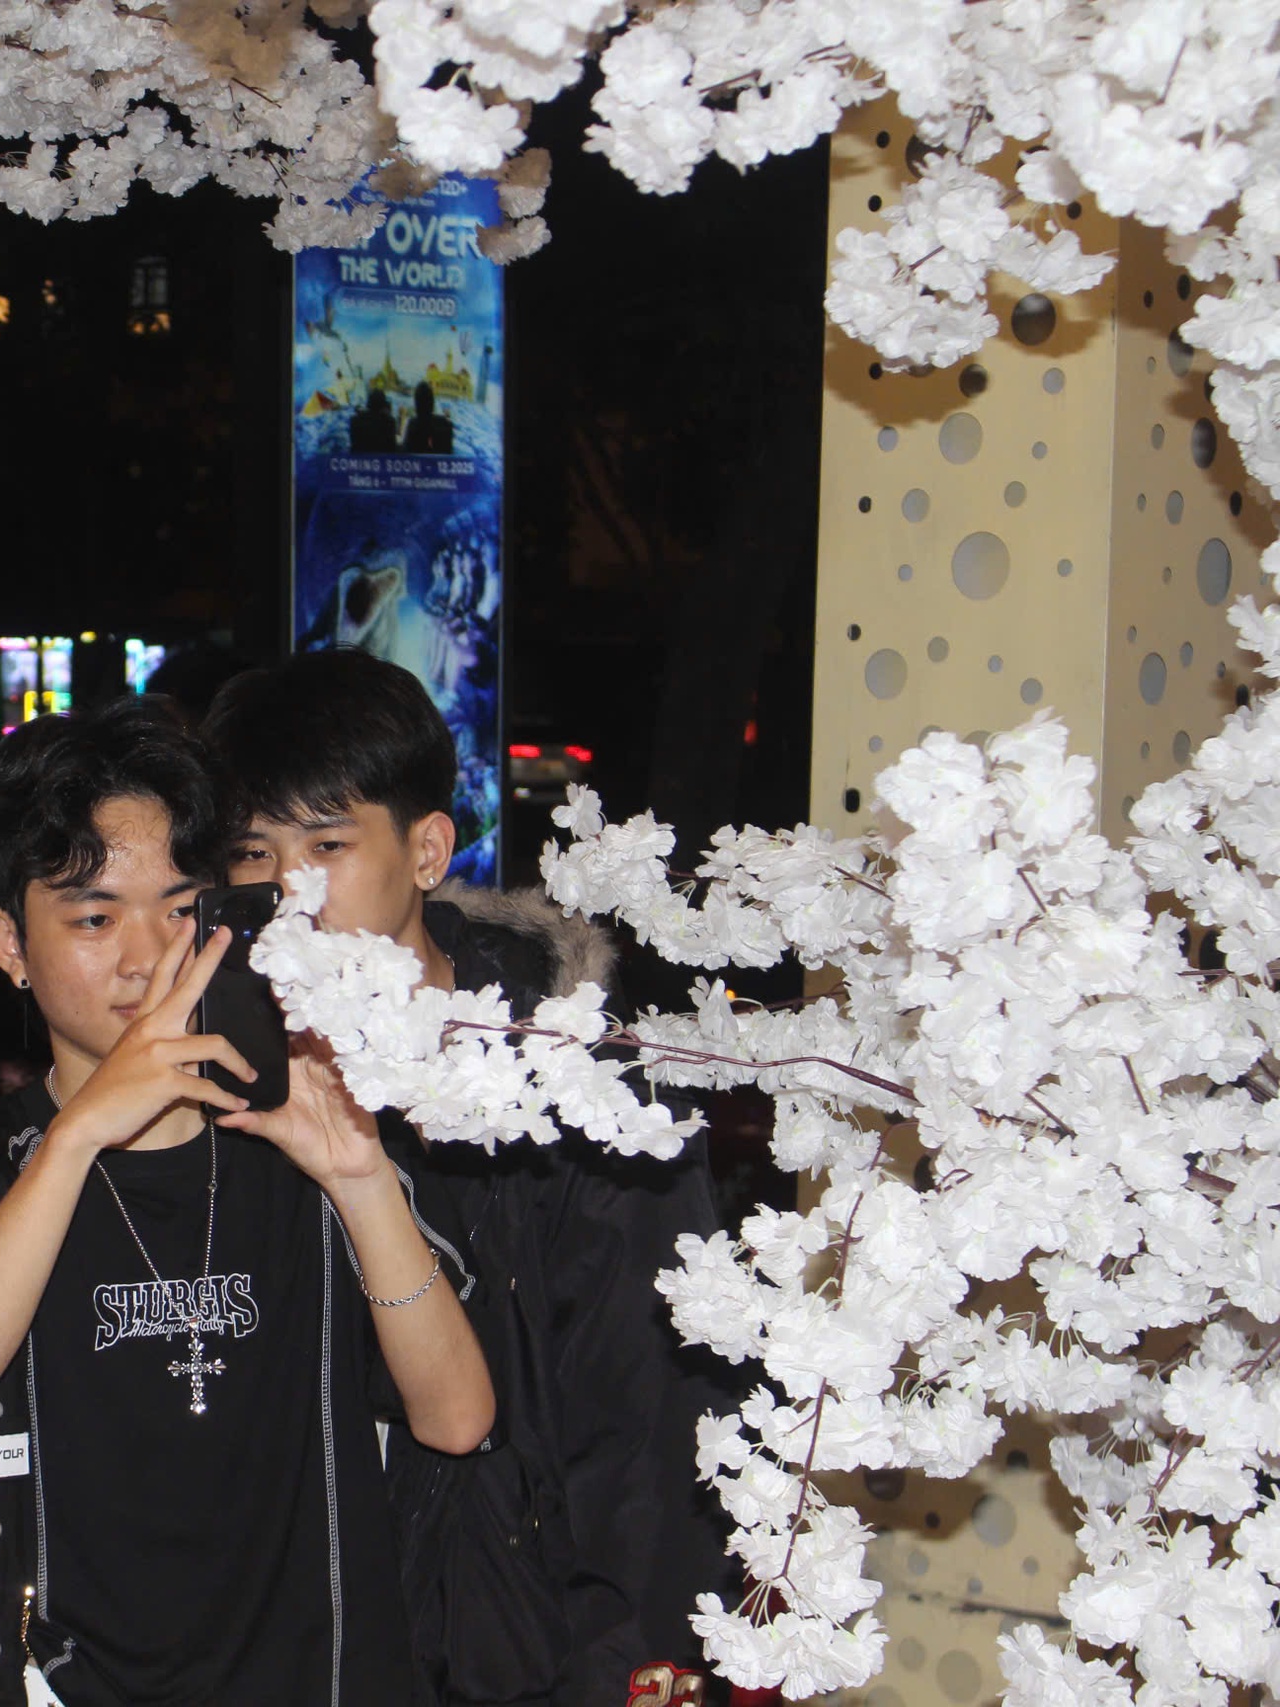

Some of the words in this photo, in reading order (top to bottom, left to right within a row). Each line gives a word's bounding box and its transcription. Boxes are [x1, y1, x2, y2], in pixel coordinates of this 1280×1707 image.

[386, 210, 484, 257] OVER
[339, 256, 379, 283] THE
[385, 259, 465, 289] WORLD
[330, 458, 381, 472] COMING
[386, 460, 422, 473] SOON
[93, 1273, 259, 1351] STURGIS
